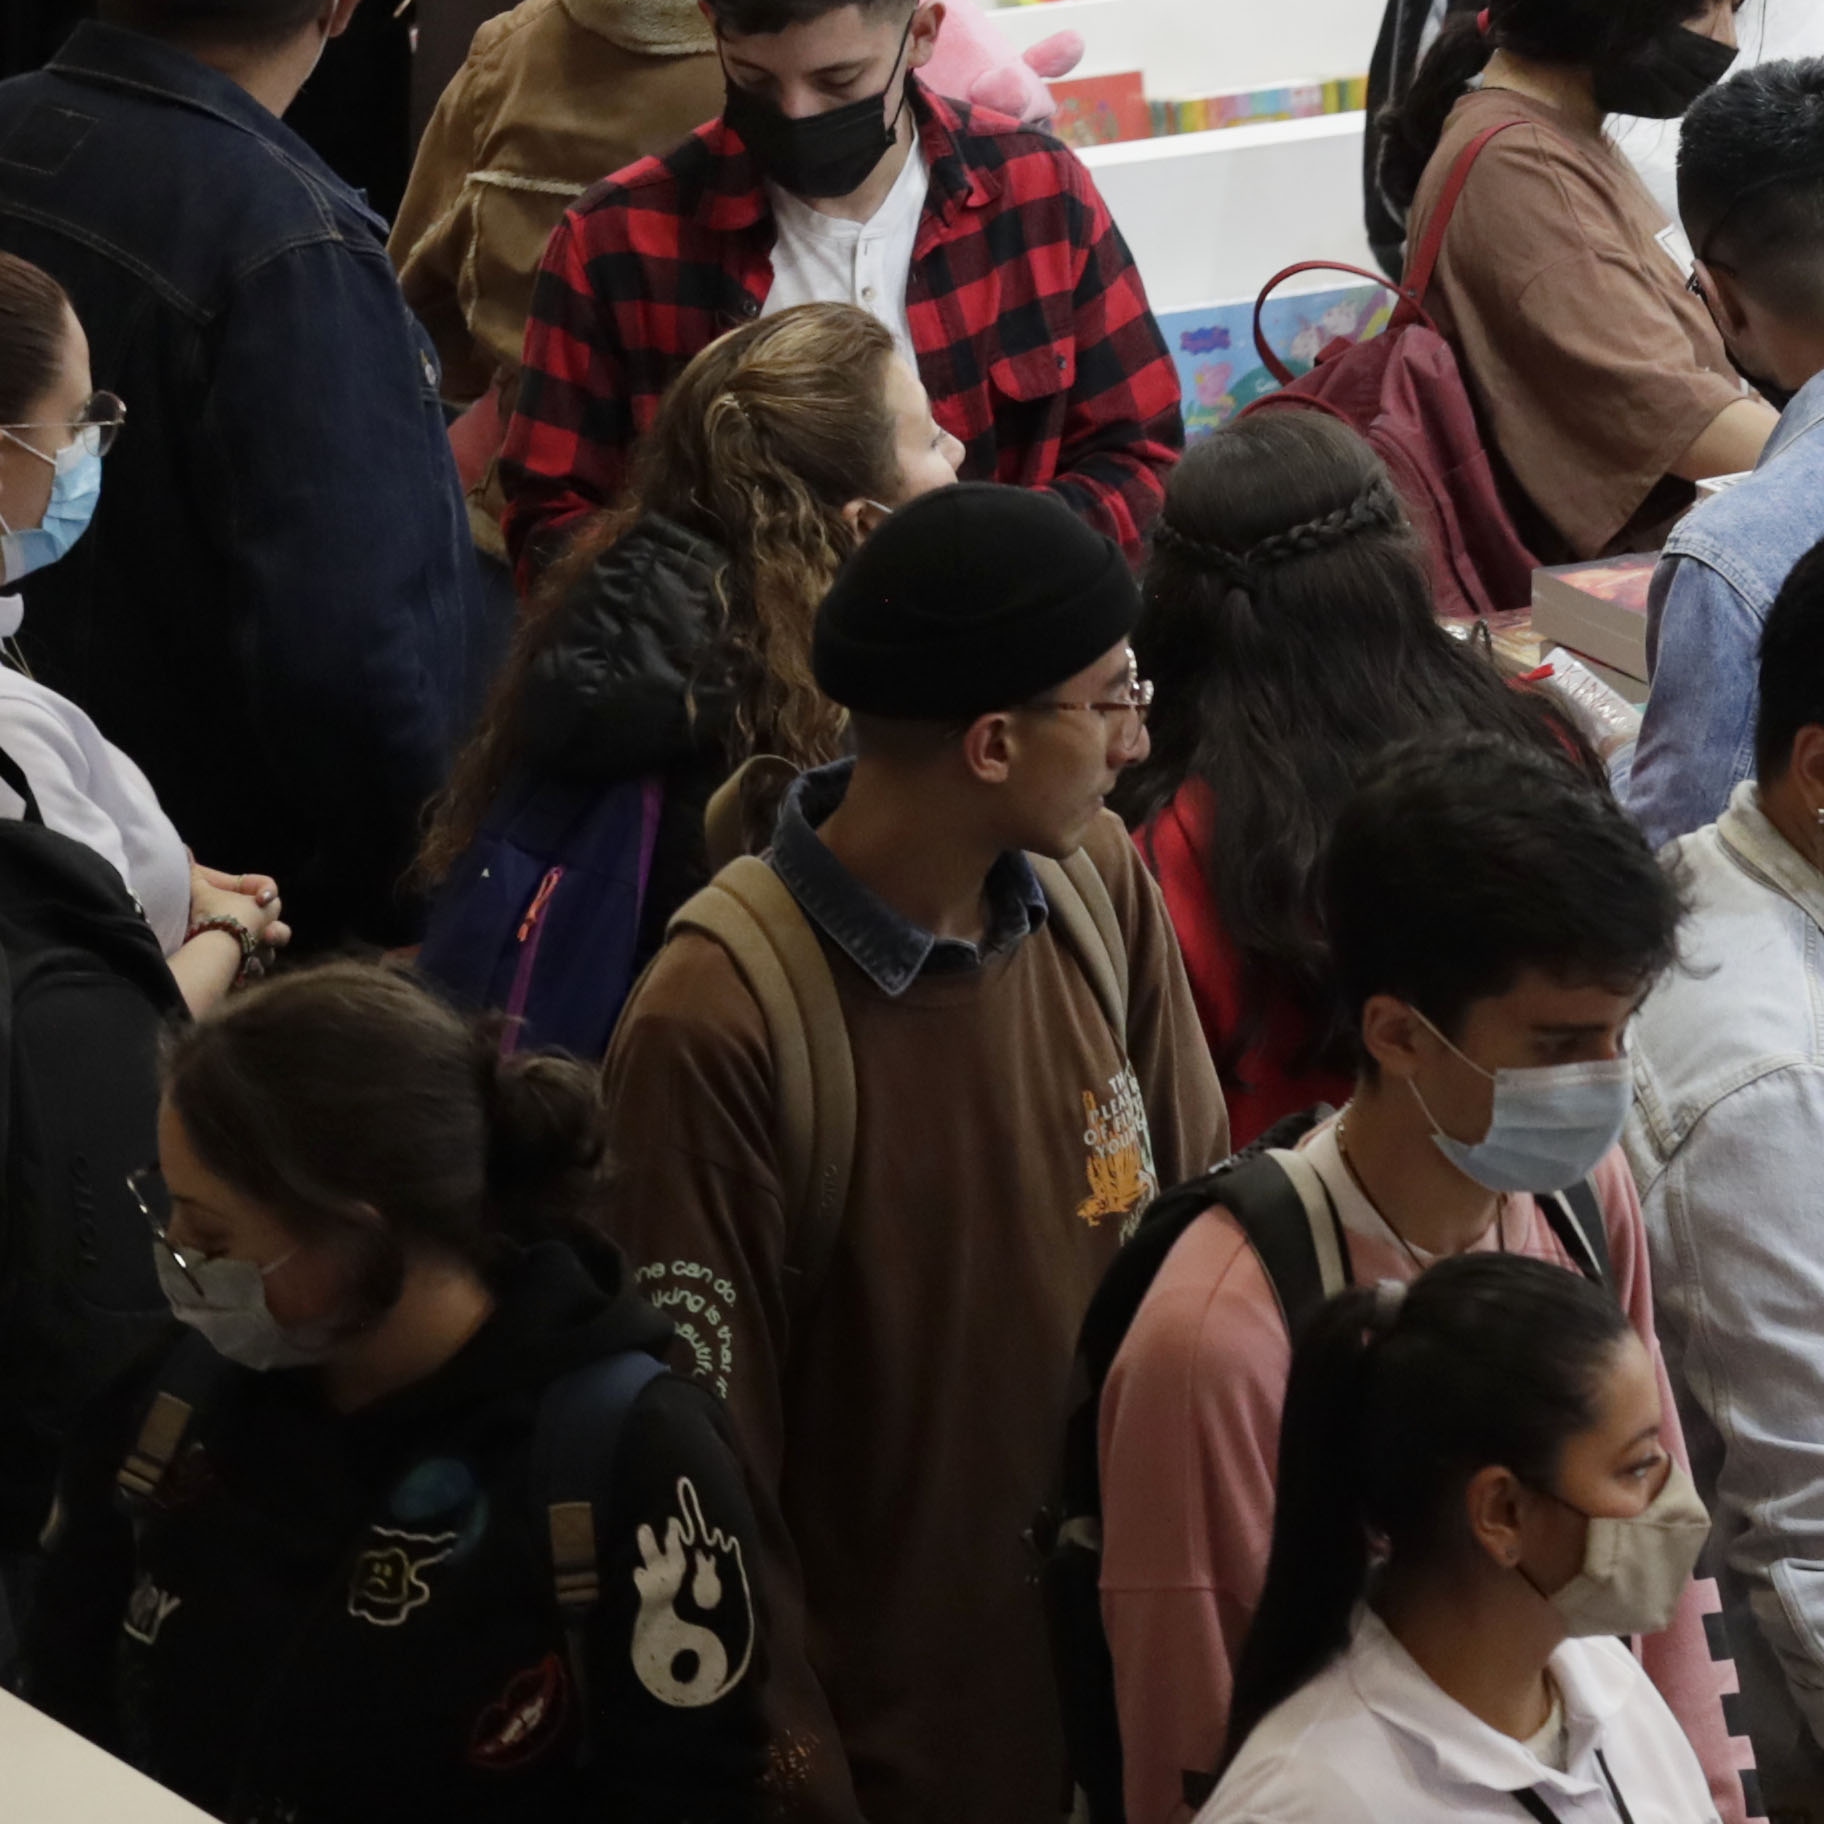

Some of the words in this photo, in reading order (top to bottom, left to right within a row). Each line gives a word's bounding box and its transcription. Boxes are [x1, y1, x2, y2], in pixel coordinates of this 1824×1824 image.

[635, 1262, 666, 1283] ne
[671, 1260, 713, 1284] can
[704, 1304, 721, 1326] is
